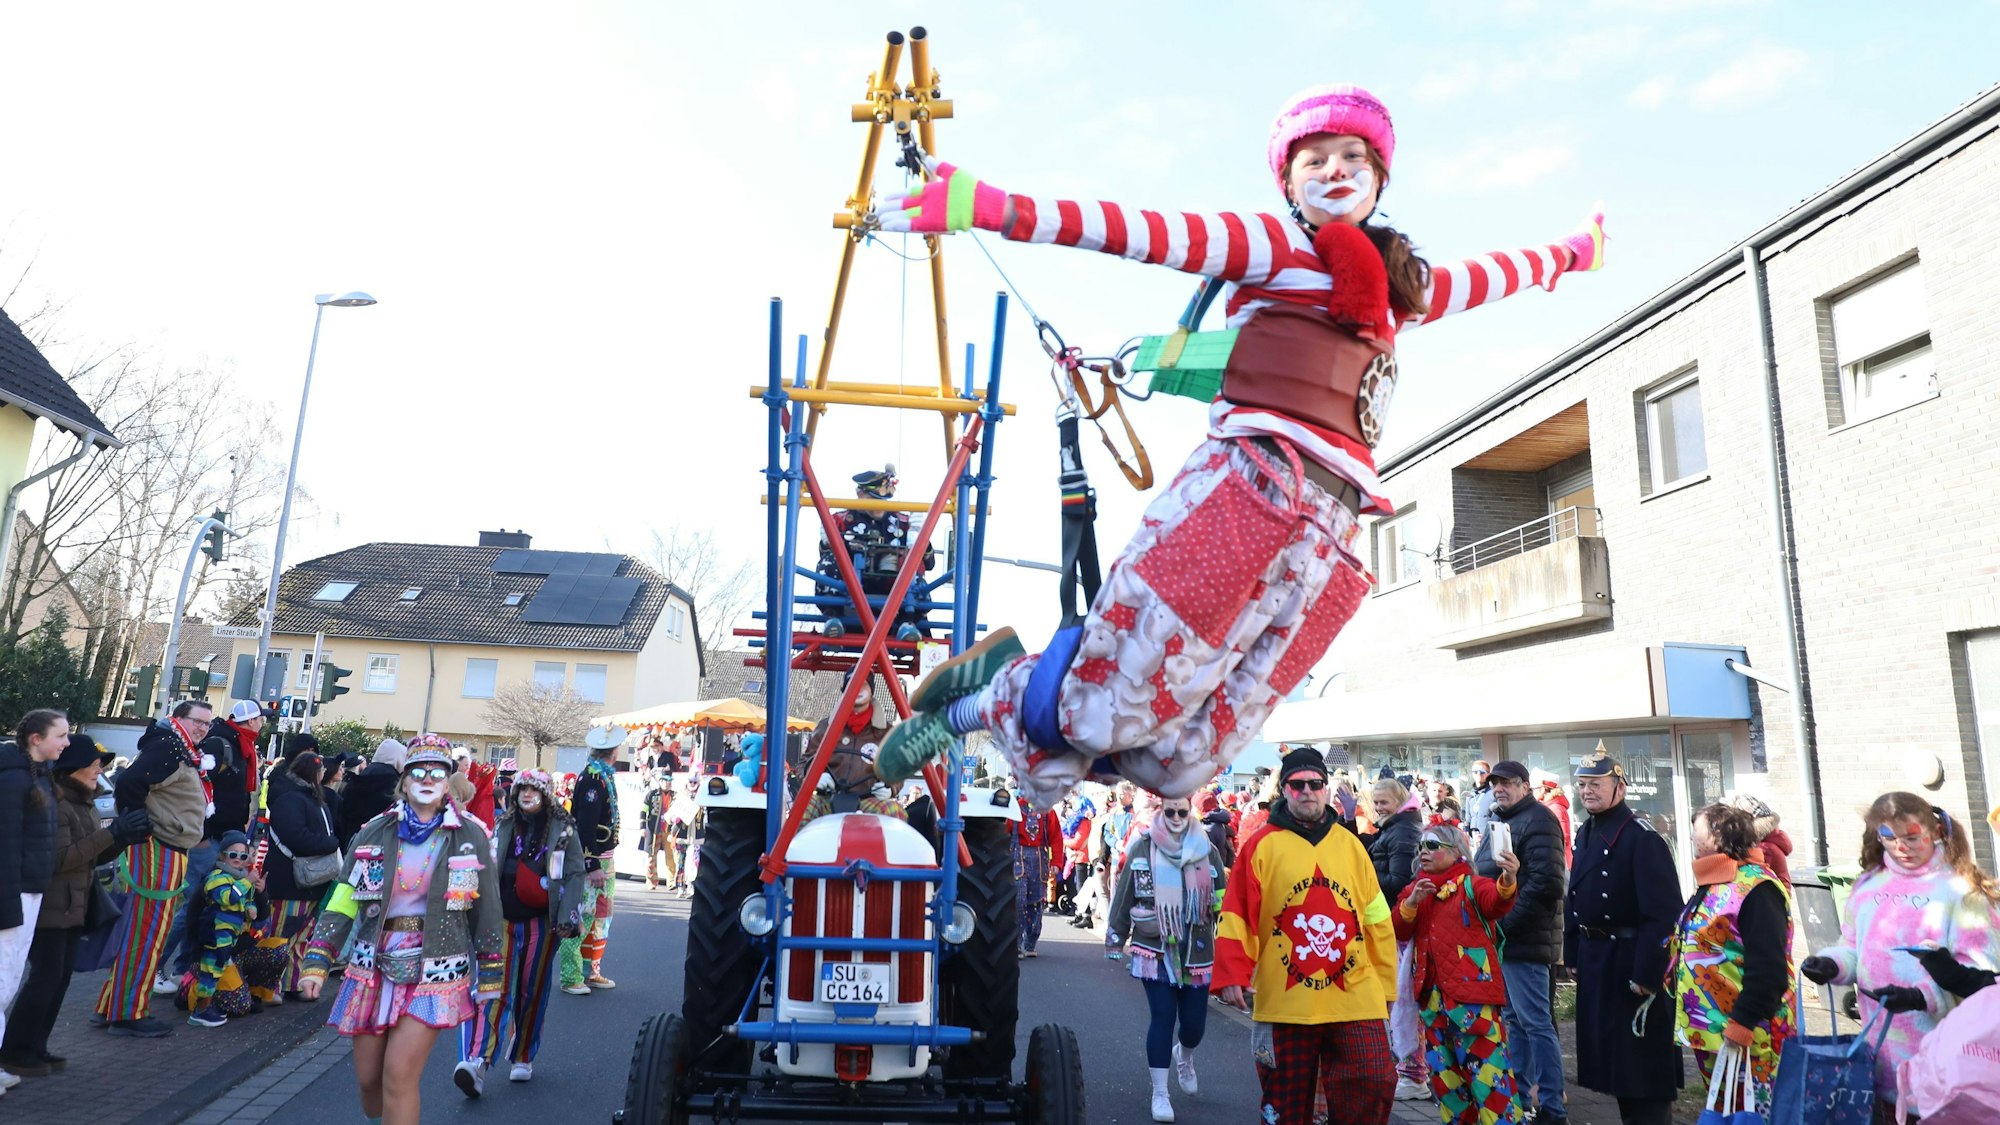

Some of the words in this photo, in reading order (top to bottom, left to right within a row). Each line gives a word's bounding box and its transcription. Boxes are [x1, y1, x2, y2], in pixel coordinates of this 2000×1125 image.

[216, 627, 235, 636] Linzer
[236, 629, 257, 637] Straße
[834, 965, 856, 981] SU
[1280, 954, 1357, 991] DÜSSELDORF
[826, 984, 848, 1000] CC
[852, 984, 883, 1001] 164
[1825, 1087, 1875, 1110] STIT
